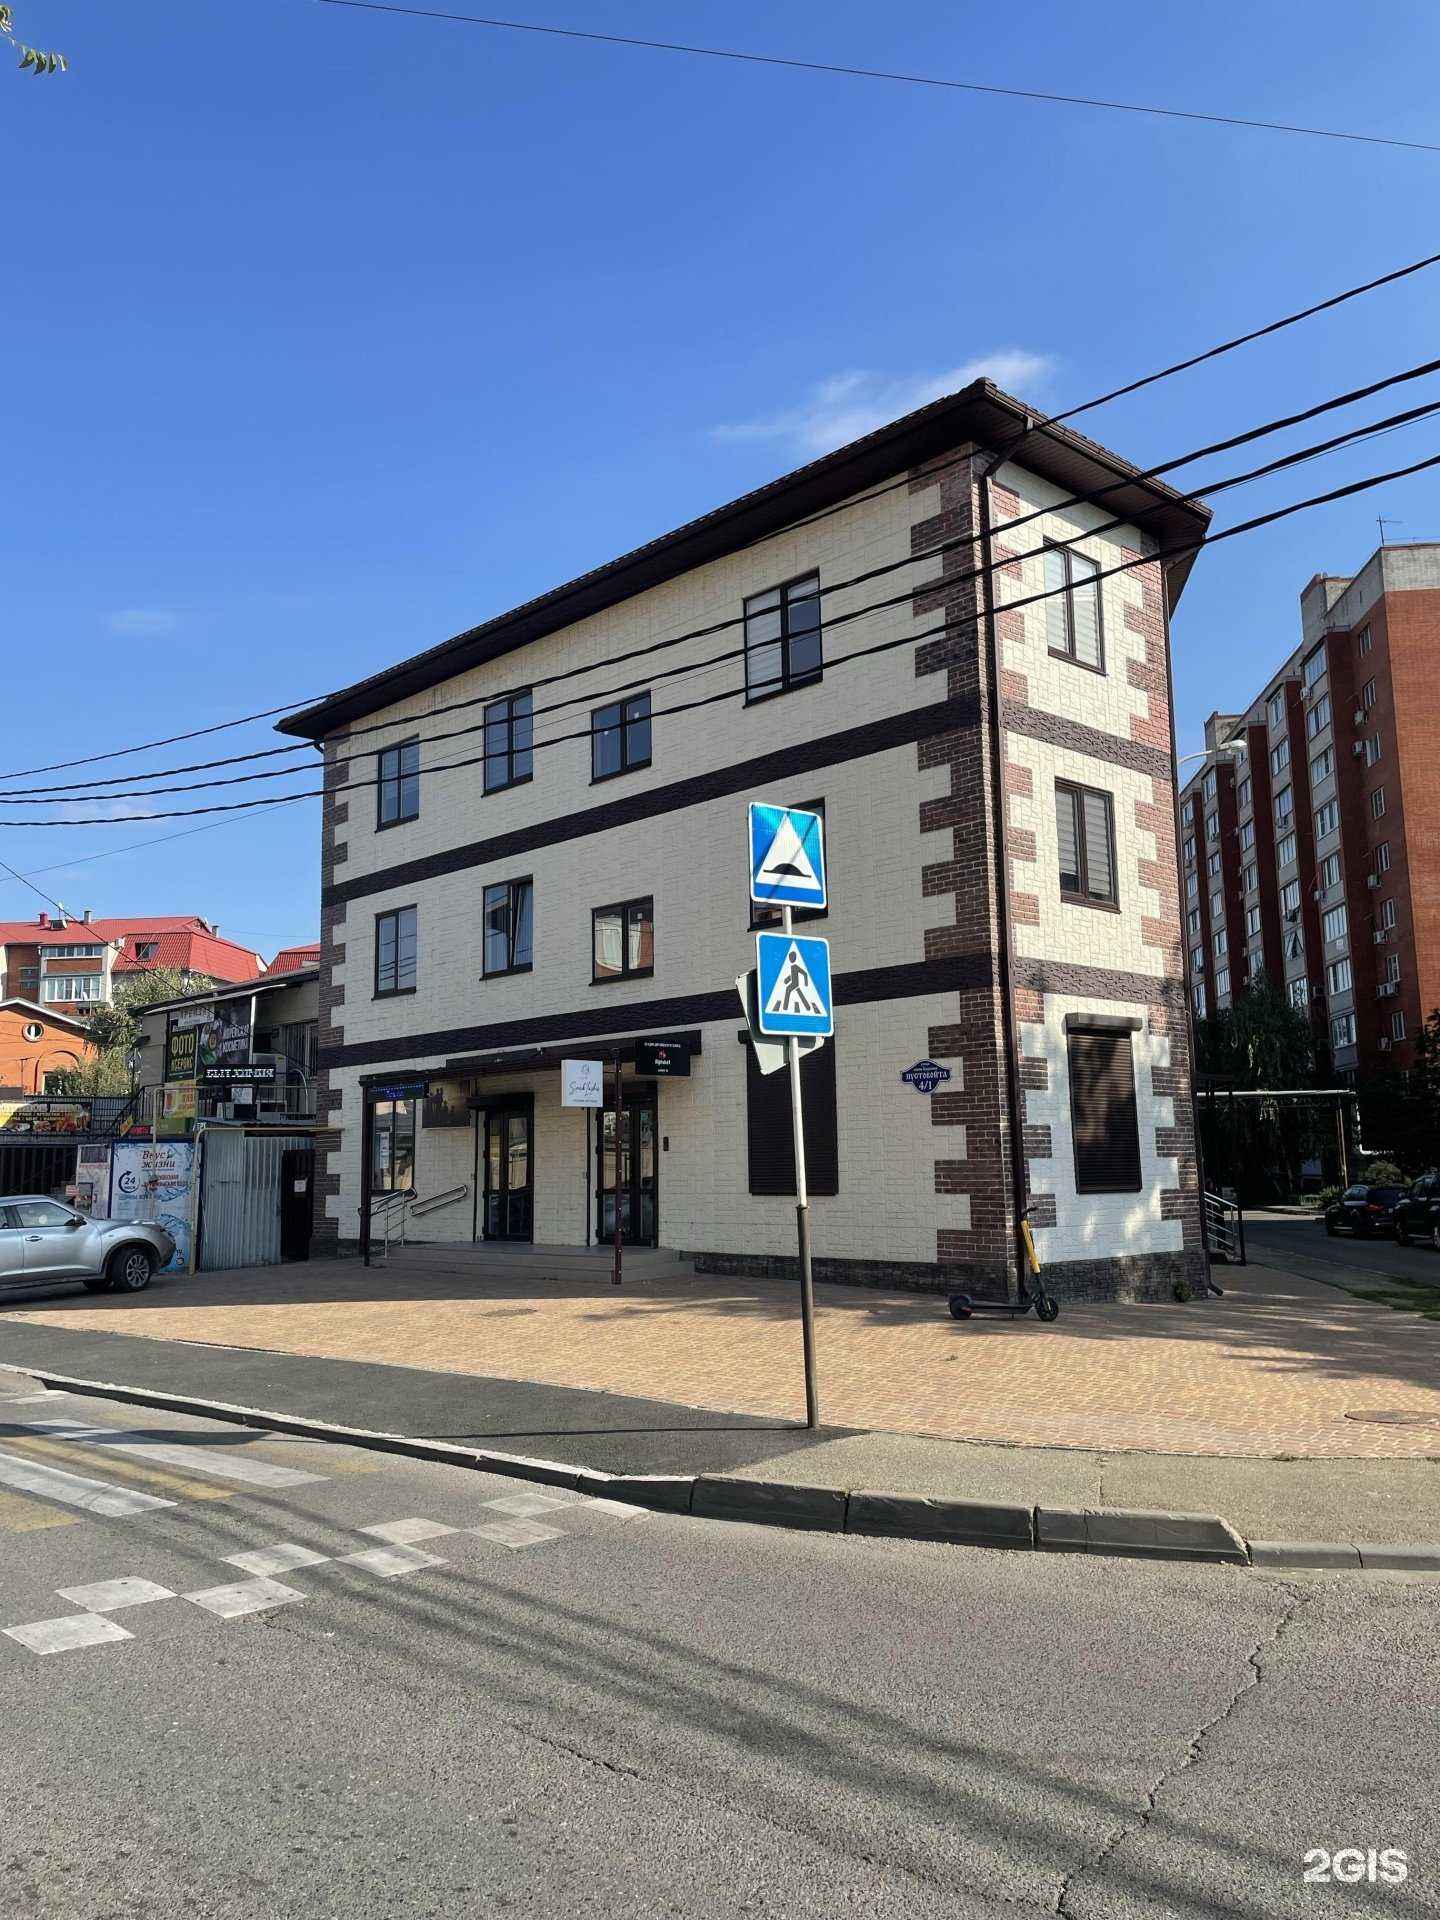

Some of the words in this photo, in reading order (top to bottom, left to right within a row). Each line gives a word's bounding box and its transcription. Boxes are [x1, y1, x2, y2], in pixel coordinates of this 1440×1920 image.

[171, 1033, 195, 1056] ФОТО
[919, 1080, 932, 1091] 4/1
[124, 1176, 136, 1185] 24
